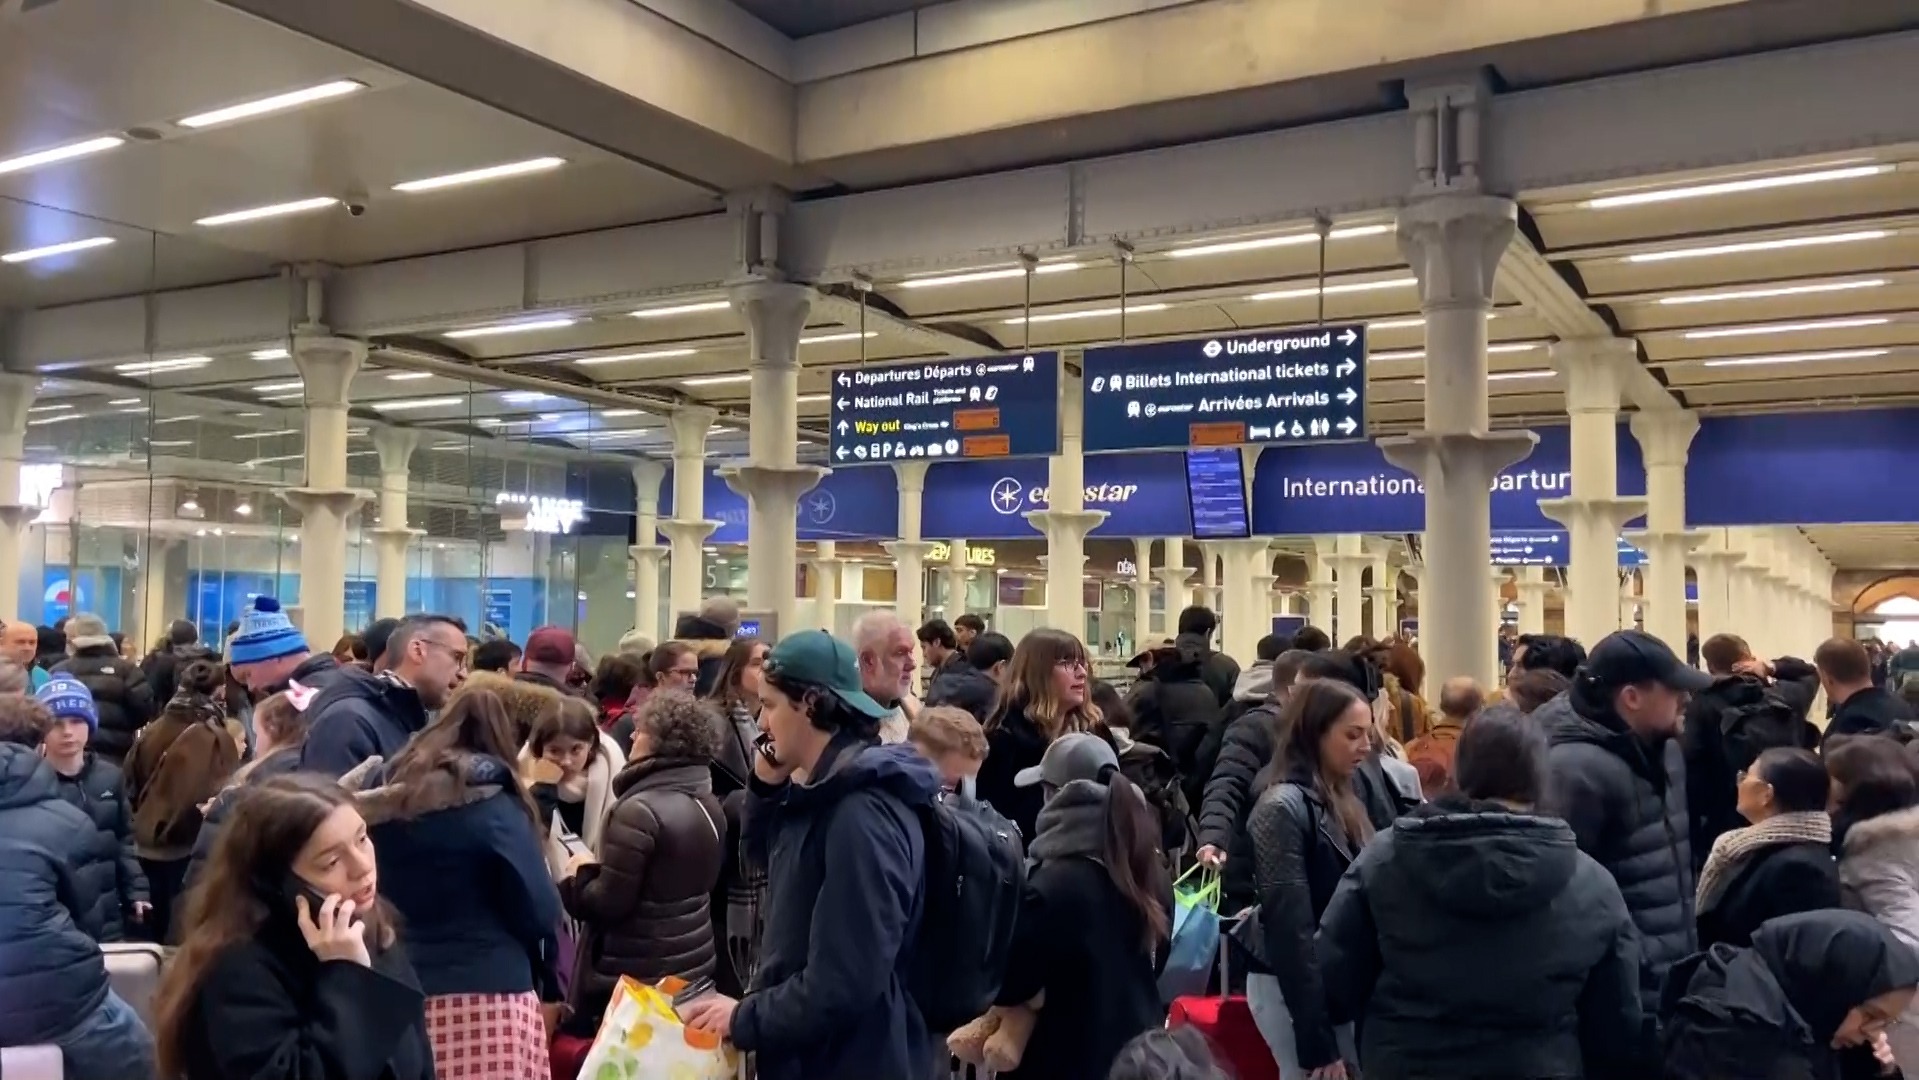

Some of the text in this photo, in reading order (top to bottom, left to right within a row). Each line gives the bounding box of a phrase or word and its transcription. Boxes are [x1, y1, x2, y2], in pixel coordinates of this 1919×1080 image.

[1227, 332, 1331, 355] Underground
[855, 369, 921, 388] Departures
[924, 364, 972, 381] Départs
[1125, 362, 1329, 390] Billets International tickets
[854, 391, 929, 410] National Rail
[1198, 394, 1262, 412] Arrivées
[1266, 391, 1330, 408] Arrivals
[855, 419, 900, 435] Way out
[705, 565, 717, 589] 5
[1123, 589, 1129, 604] 3
